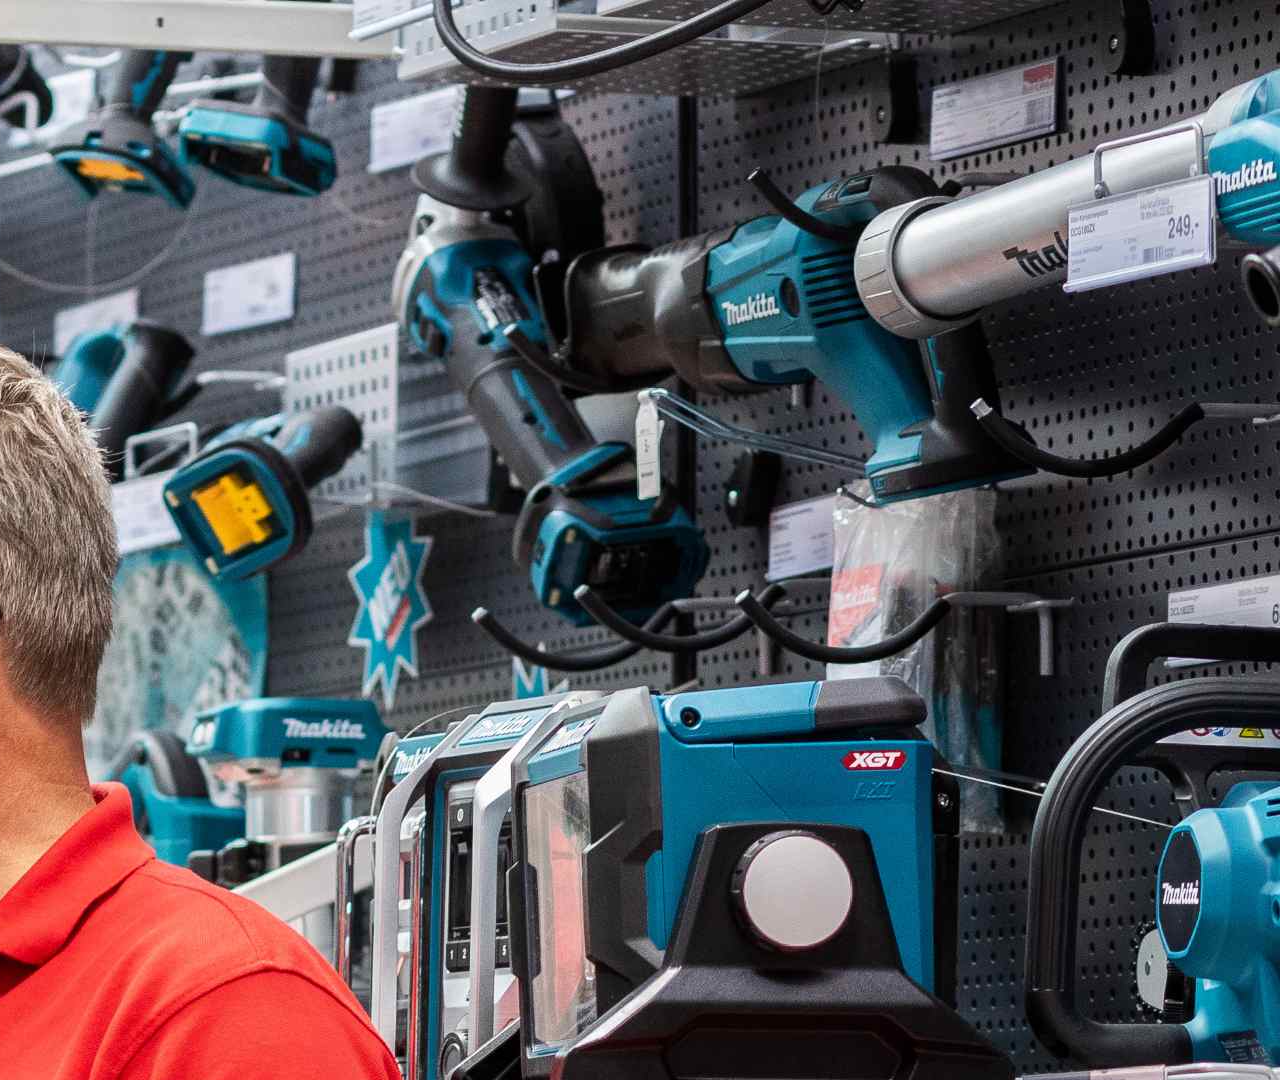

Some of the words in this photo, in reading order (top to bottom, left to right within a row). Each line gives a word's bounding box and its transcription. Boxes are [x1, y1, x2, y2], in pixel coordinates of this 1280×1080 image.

[1212, 158, 1277, 195] Makita
[1168, 214, 1199, 240] 249,-
[722, 292, 780, 326] Makita
[283, 718, 367, 739] Makita
[848, 751, 902, 768] XGT
[1162, 880, 1199, 905] Makita
